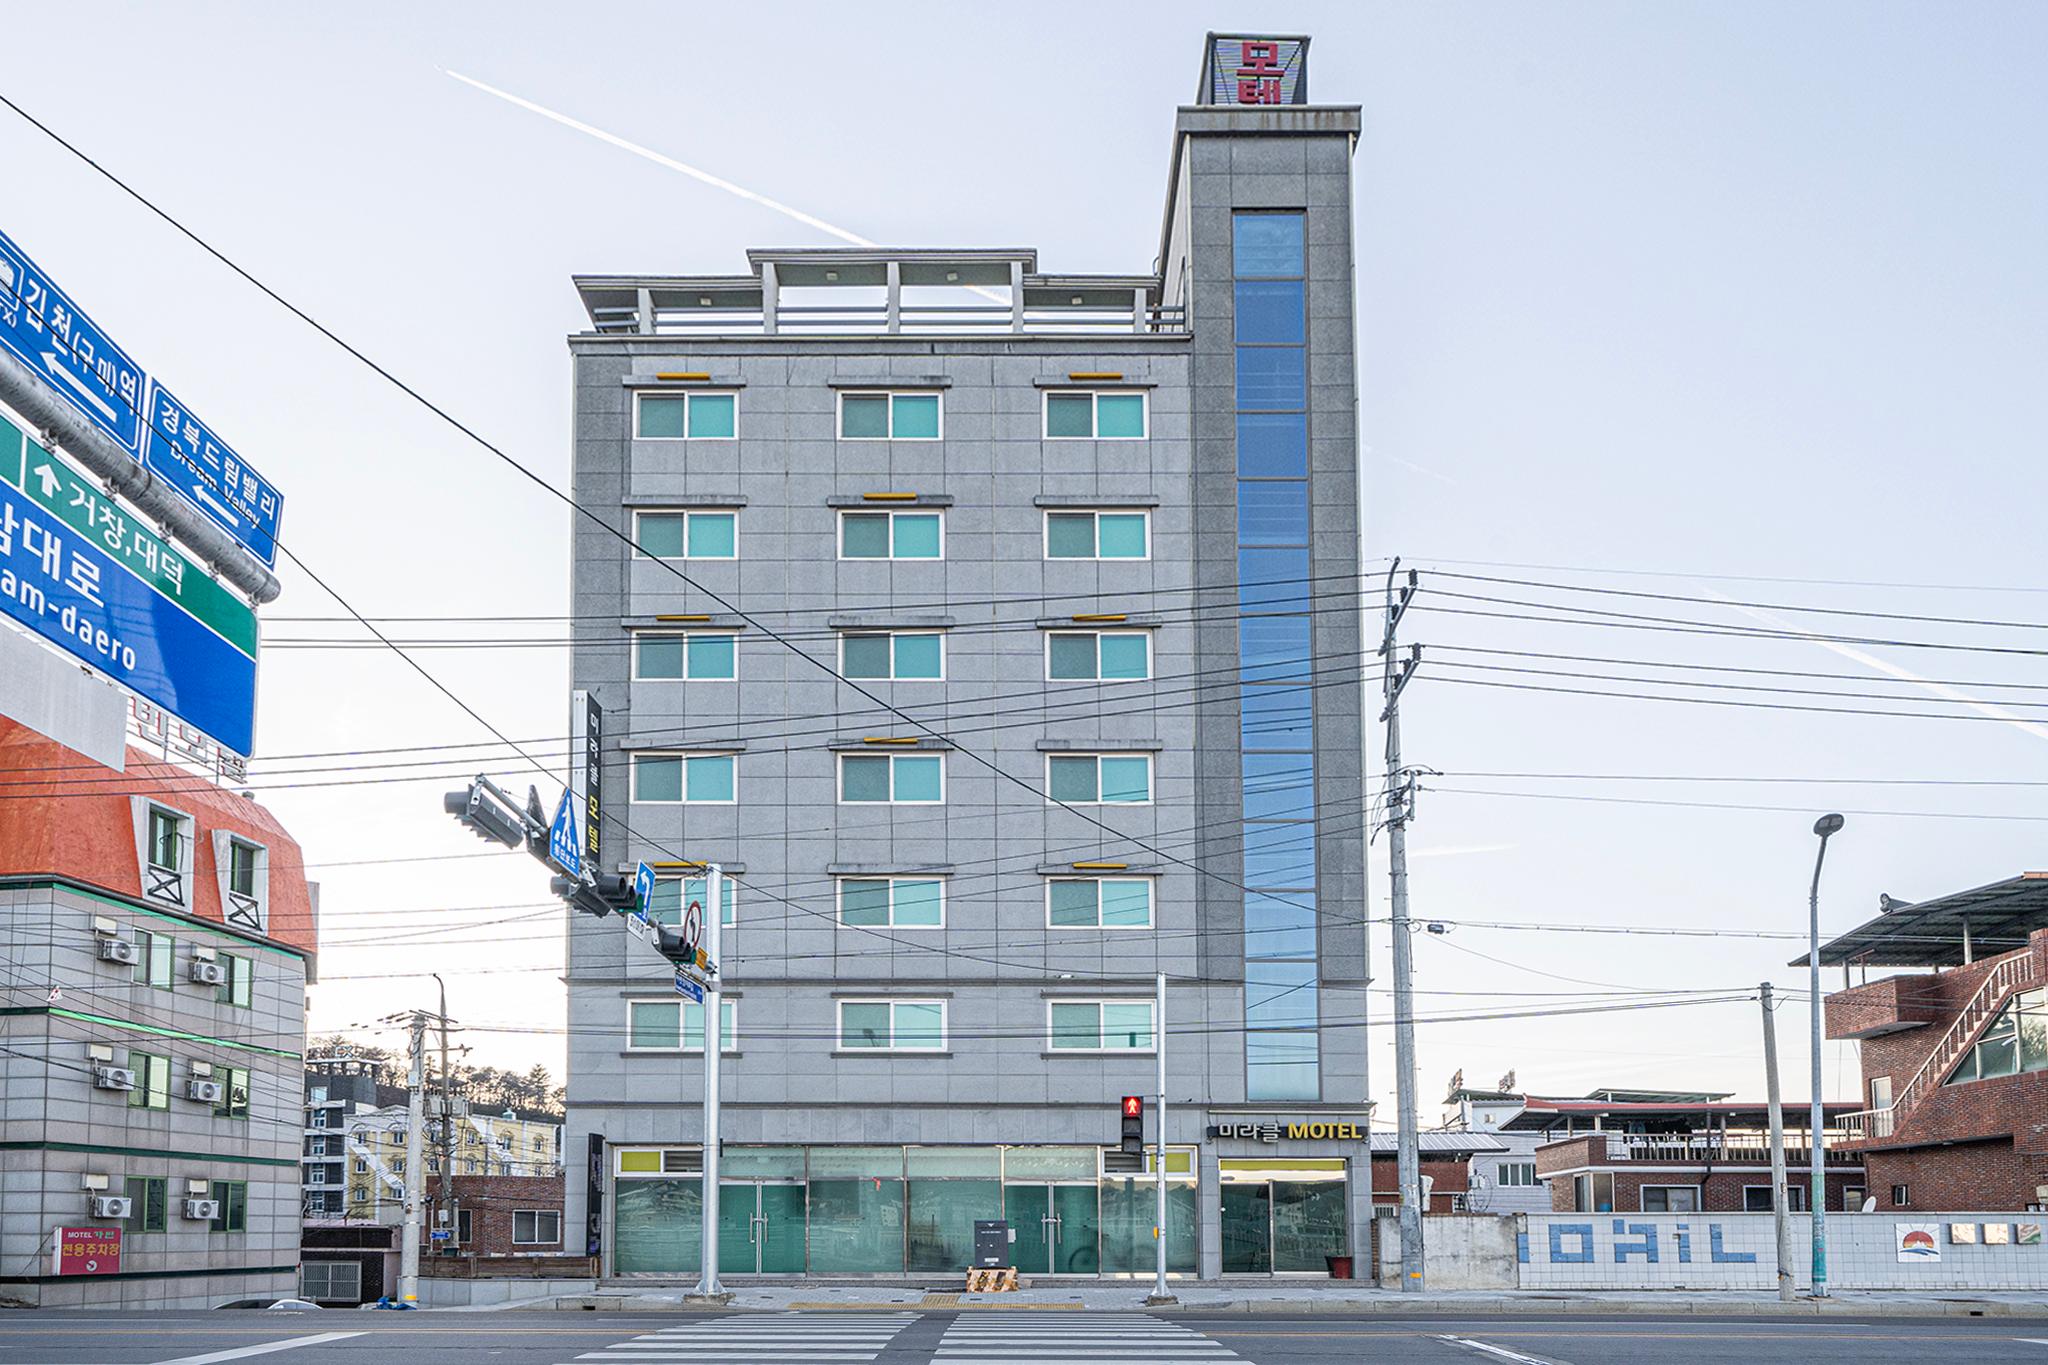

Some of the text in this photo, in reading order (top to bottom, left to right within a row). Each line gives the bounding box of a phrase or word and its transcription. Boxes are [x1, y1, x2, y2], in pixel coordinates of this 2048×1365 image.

[25, 278, 137, 416] 김천(구미)역
[161, 400, 276, 521] 경북드림밸리
[170, 439, 261, 530] Dream Valley
[1218, 1122, 1363, 1144] 미라클 MOTEL
[62, 1243, 120, 1257] 전용주차장
[67, 1231, 93, 1239] MOTEL
